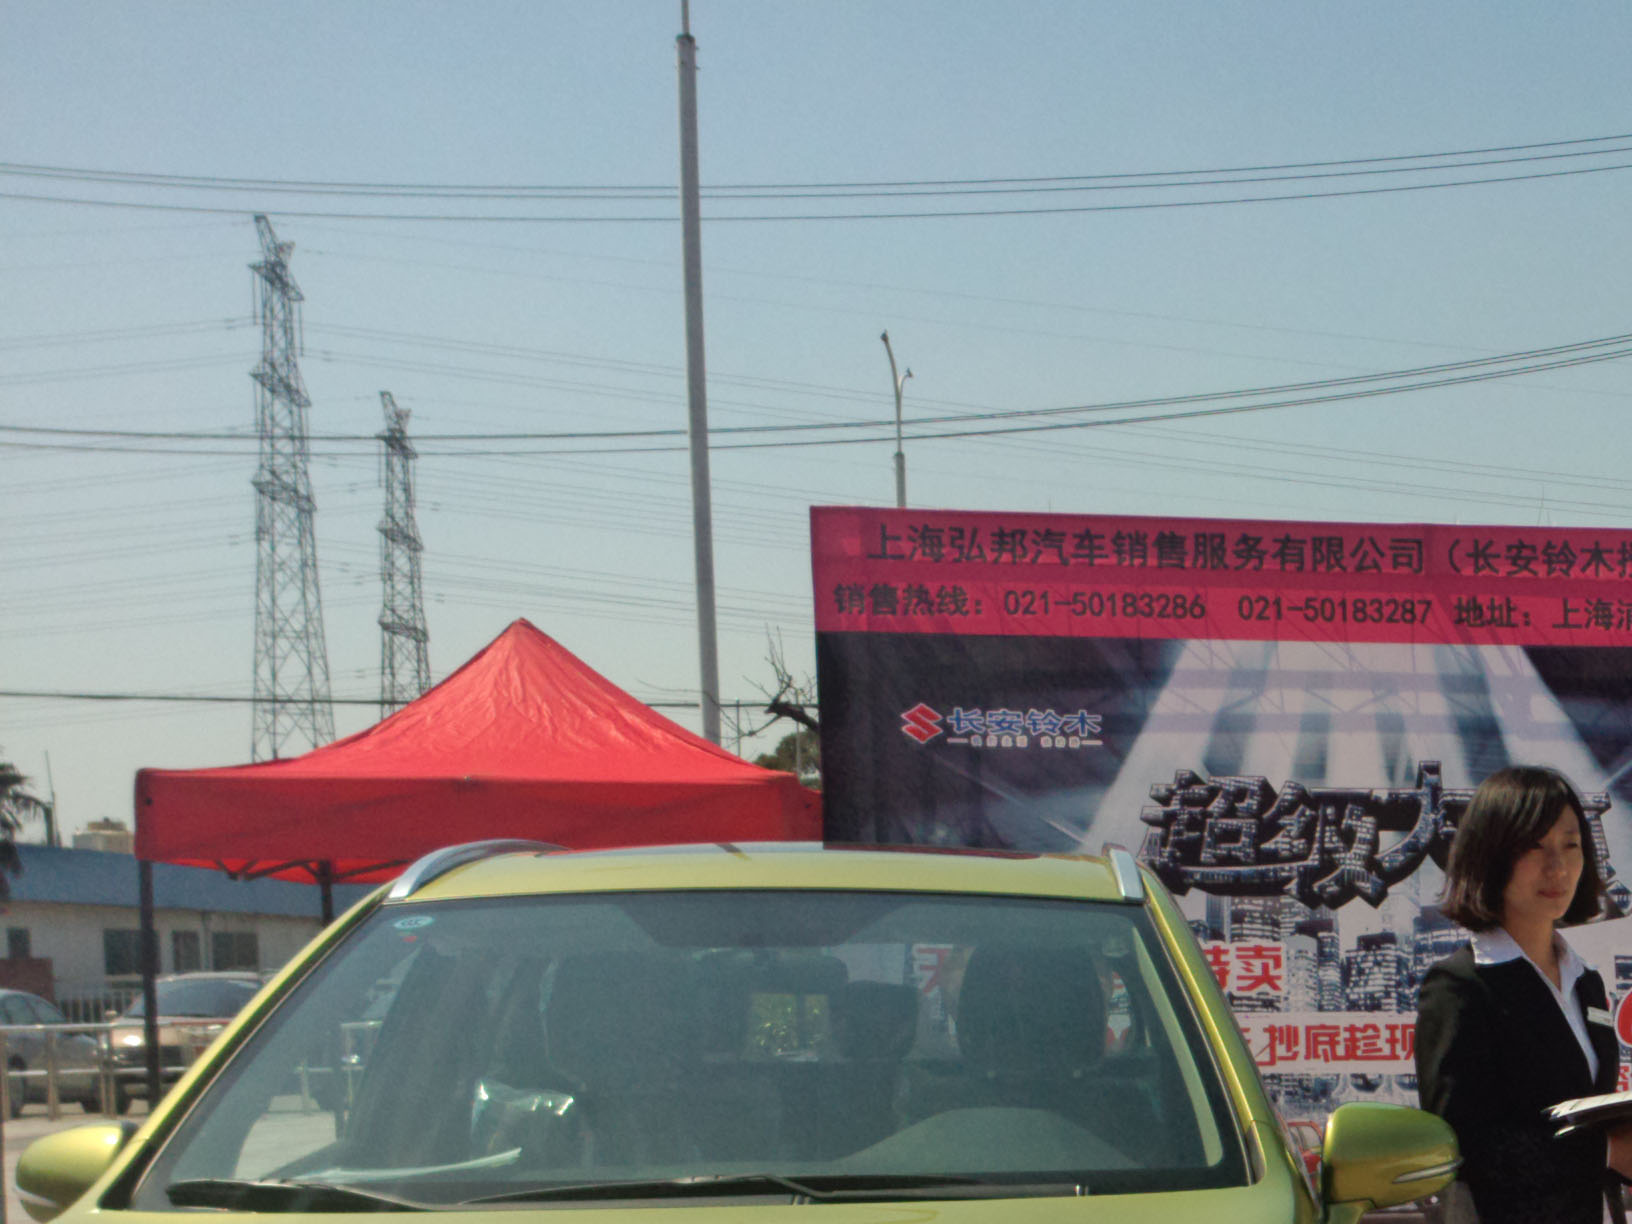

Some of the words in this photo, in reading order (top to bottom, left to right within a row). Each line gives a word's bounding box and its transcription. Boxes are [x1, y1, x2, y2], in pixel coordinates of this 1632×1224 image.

[1238, 596, 1432, 624] 021-50183287
[947, 707, 1102, 736] 长安铃木
[1243, 1023, 1418, 1066] 抄底趁现
